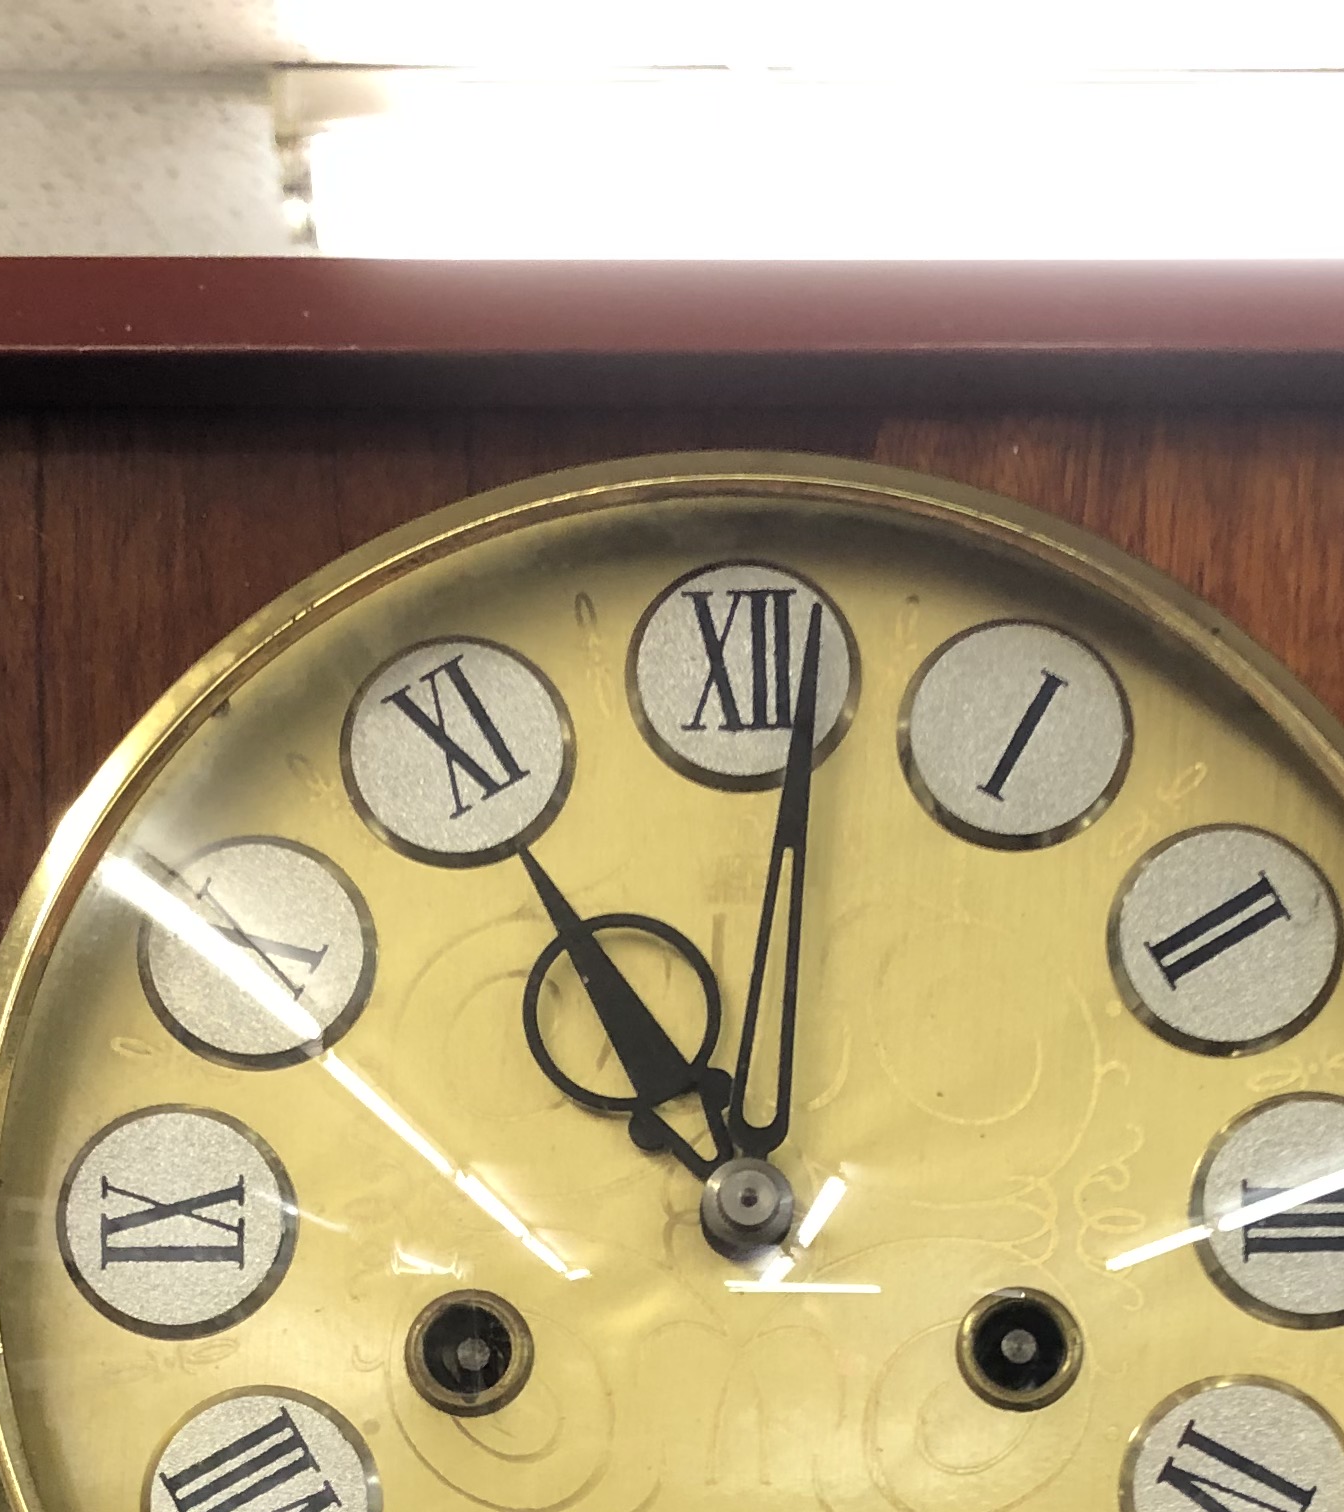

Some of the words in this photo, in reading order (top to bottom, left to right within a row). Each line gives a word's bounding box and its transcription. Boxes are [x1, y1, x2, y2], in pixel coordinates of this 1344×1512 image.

[680, 588, 797, 732] XII
[381, 654, 531, 820] XI
[976, 667, 1069, 802] I
[196, 876, 330, 1002] X
[1143, 869, 1292, 991] II
[101, 1173, 245, 1271] IX
